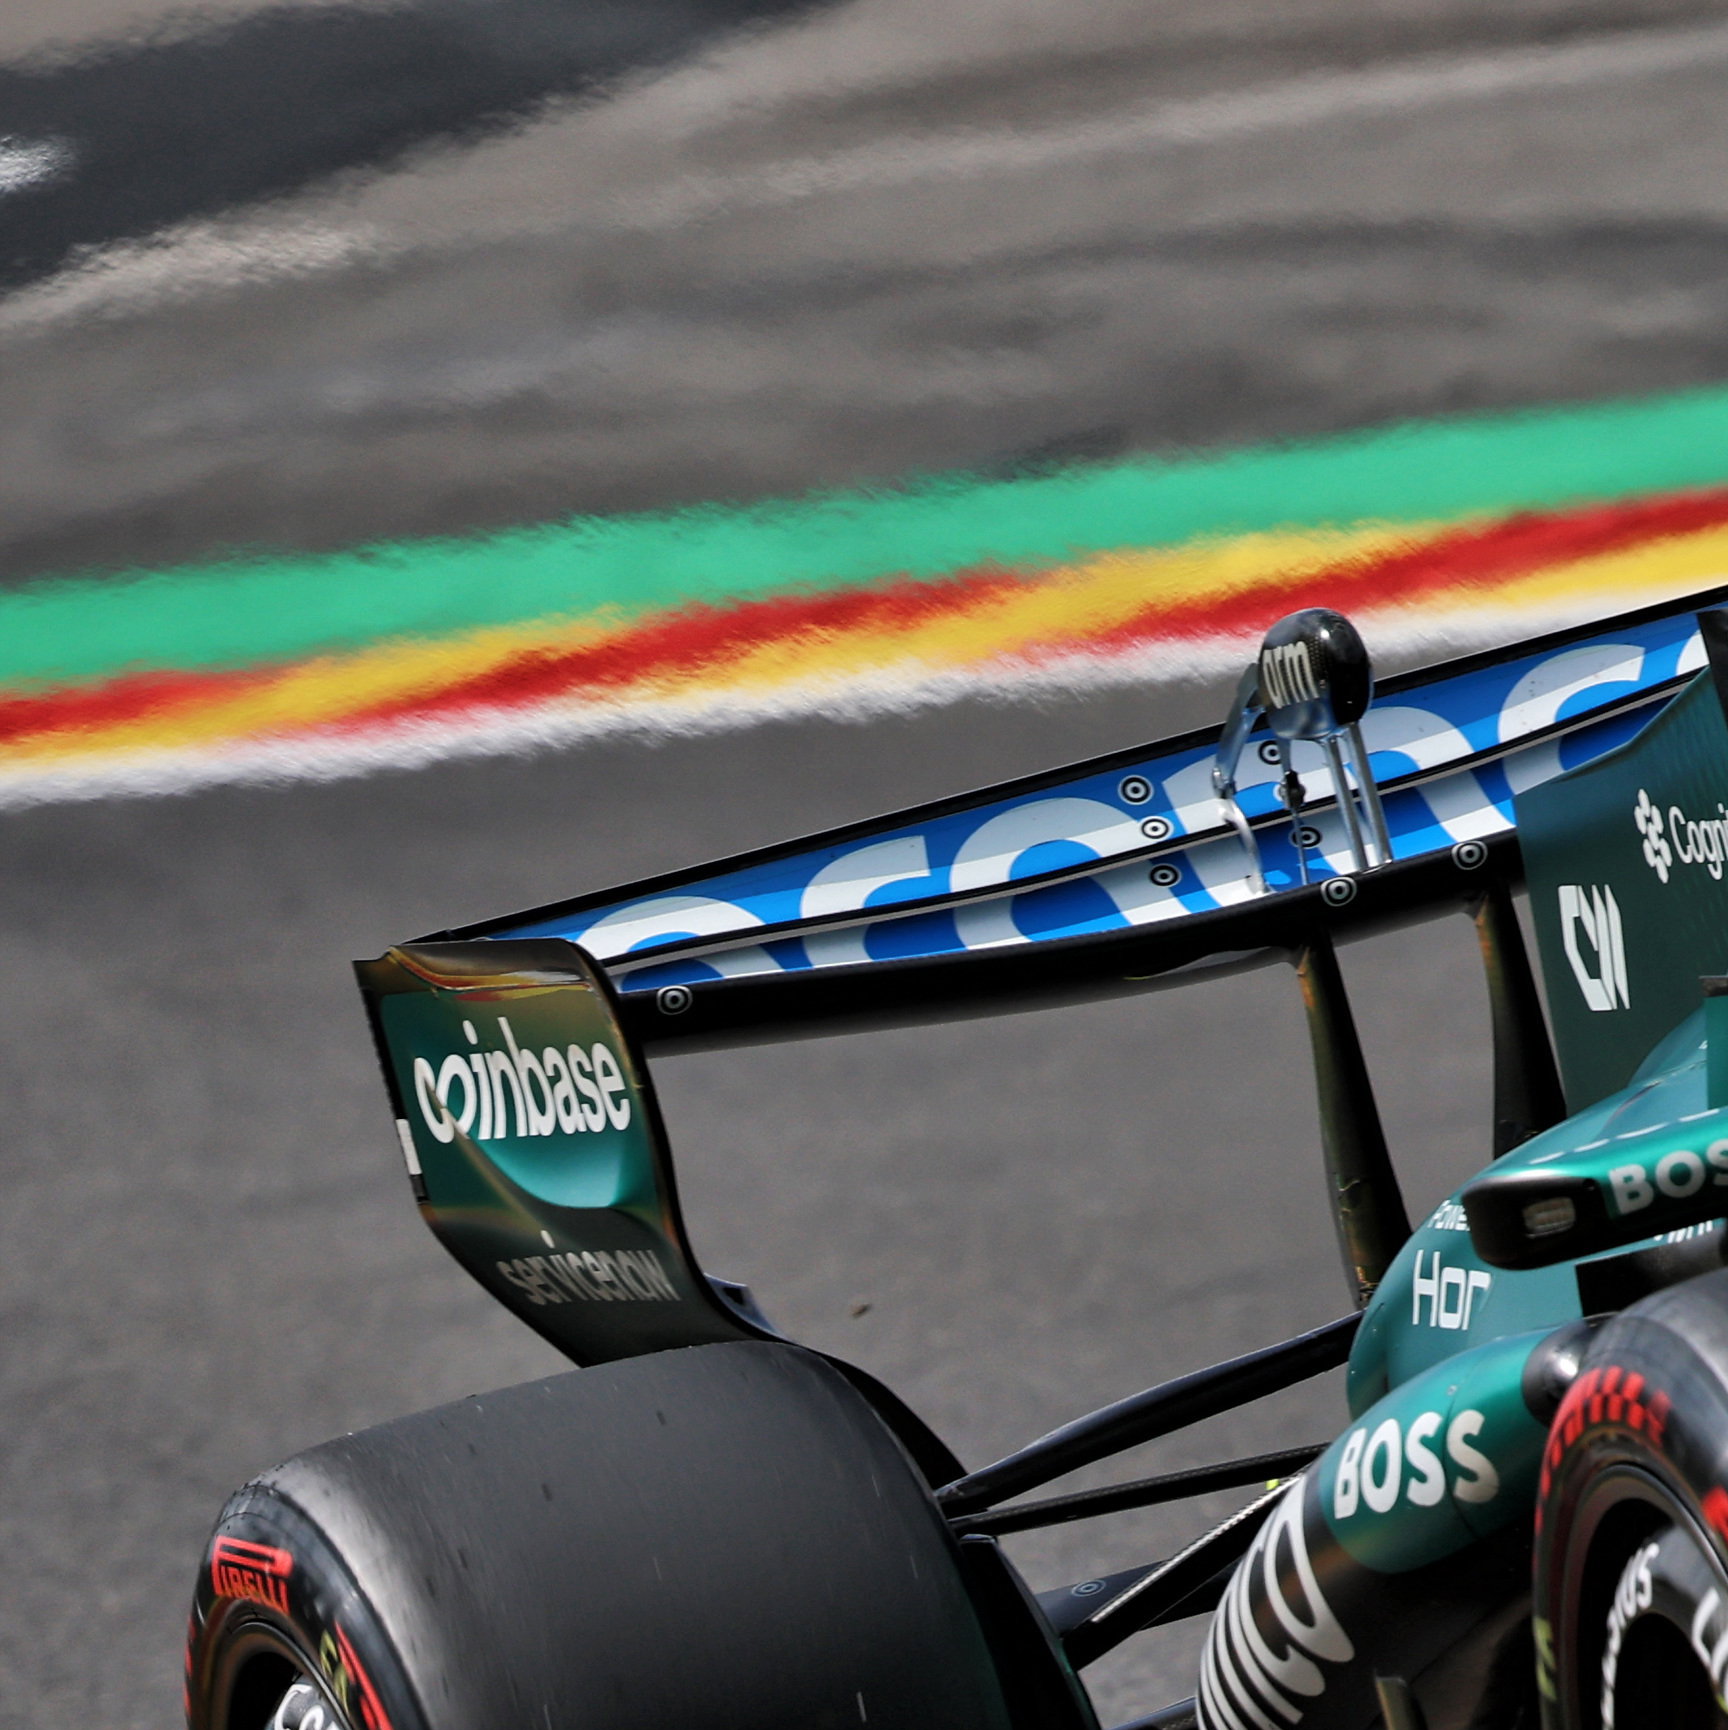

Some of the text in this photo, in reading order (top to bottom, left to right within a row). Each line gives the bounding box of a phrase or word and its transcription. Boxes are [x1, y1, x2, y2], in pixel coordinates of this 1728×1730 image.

[1262, 641, 1319, 709] arm
[414, 1017, 634, 1143] coinbase
[1335, 1409, 1500, 1520] BOSS
[211, 1535, 294, 1615] PIRELLI
